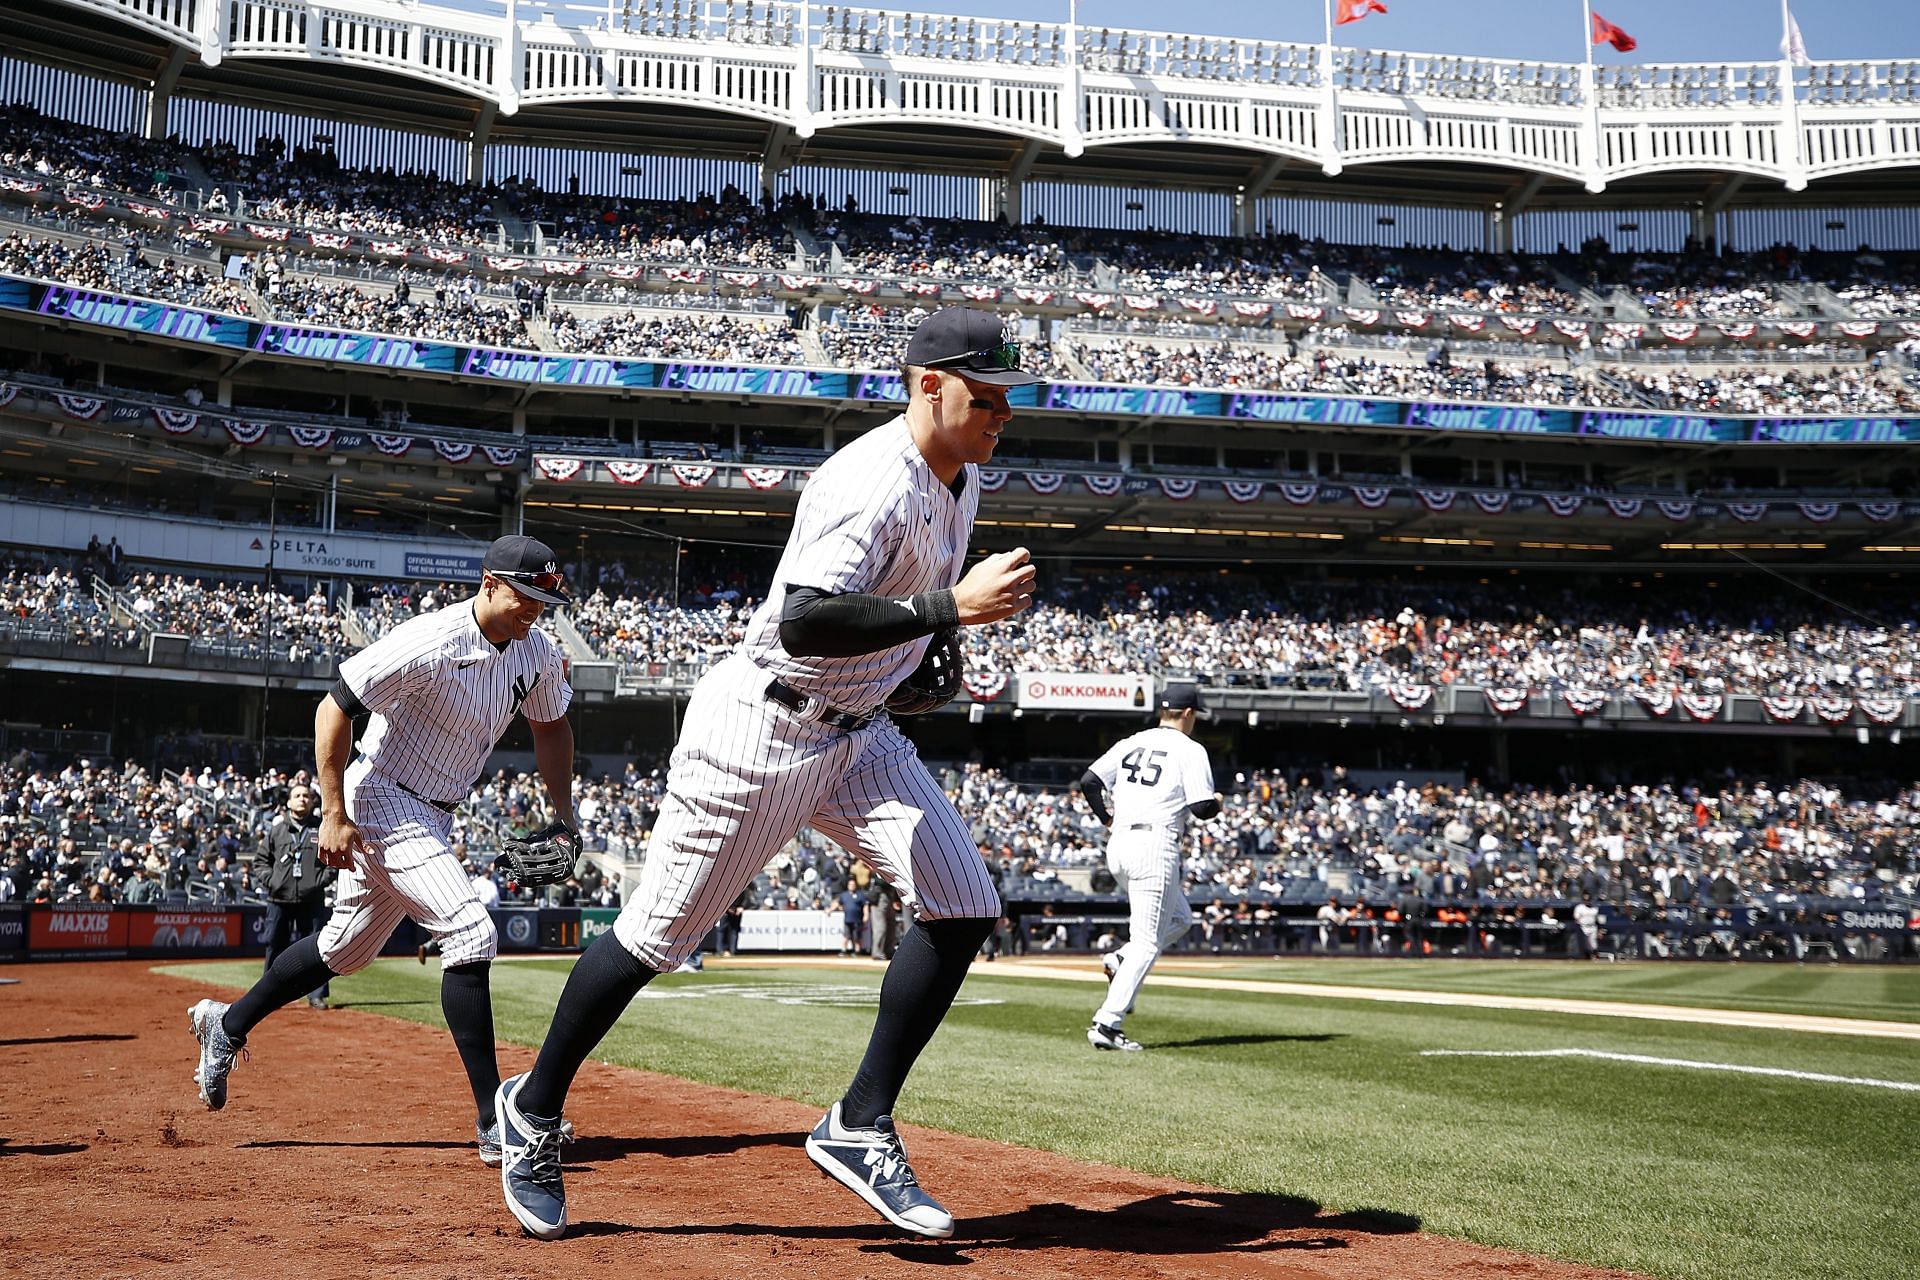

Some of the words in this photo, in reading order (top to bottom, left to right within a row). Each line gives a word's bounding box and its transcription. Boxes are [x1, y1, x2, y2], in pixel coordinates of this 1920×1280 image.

[112, 406, 142, 420] 1956
[270, 539, 327, 554] DELTA
[407, 556, 434, 567] OFFICIAL
[435, 558, 458, 568] AIRLINE
[459, 560, 468, 569] OF
[408, 565, 419, 574] THE
[420, 566, 435, 575] NEW
[436, 567, 453, 576] YORK
[1050, 685, 1128, 698] KIKKOMAN
[1121, 746, 1168, 787] 45
[48, 913, 110, 933] MAXXIS
[1841, 910, 1905, 930] StubHub
[83, 934, 109, 945] TIRES
